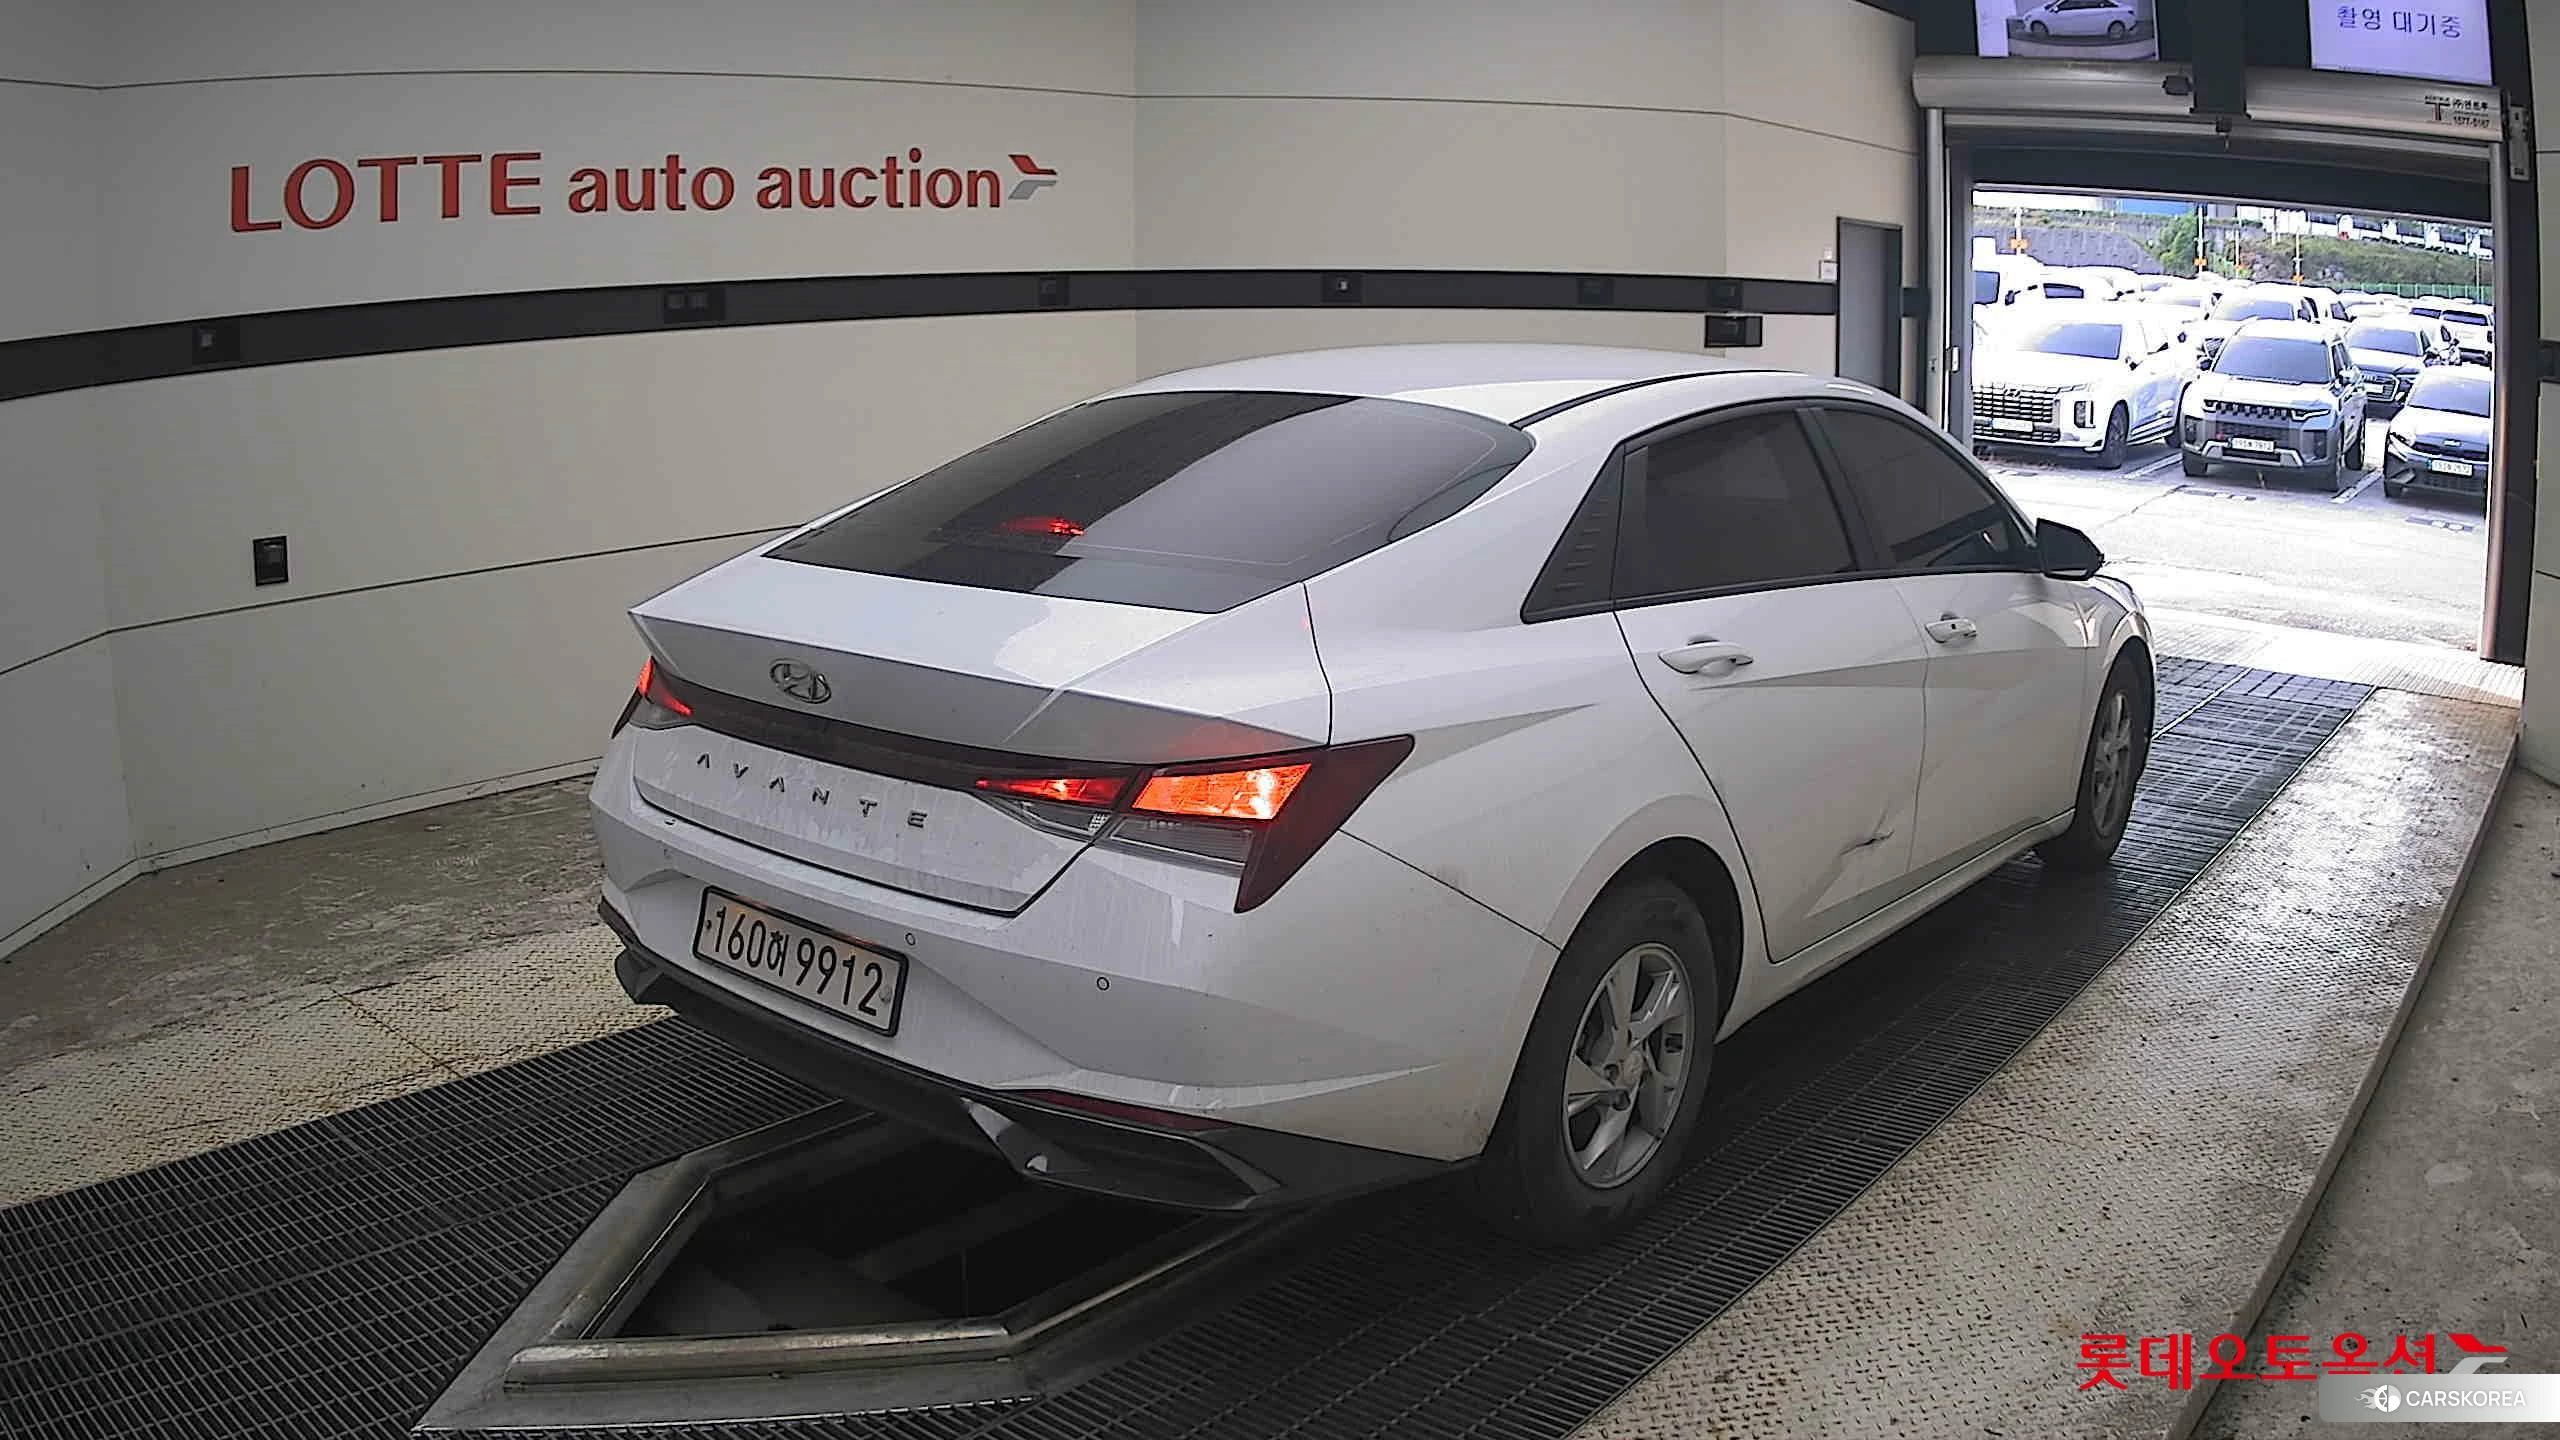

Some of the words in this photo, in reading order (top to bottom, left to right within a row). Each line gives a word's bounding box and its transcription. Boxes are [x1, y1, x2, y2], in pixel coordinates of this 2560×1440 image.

[2337, 6, 2381, 30] 촬영
[2393, 11, 2461, 38] 대기중
[231, 152, 541, 233] LOTTE
[568, 153, 735, 213] auto
[756, 147, 1001, 210] auction
[697, 753, 927, 828] AVANTE
